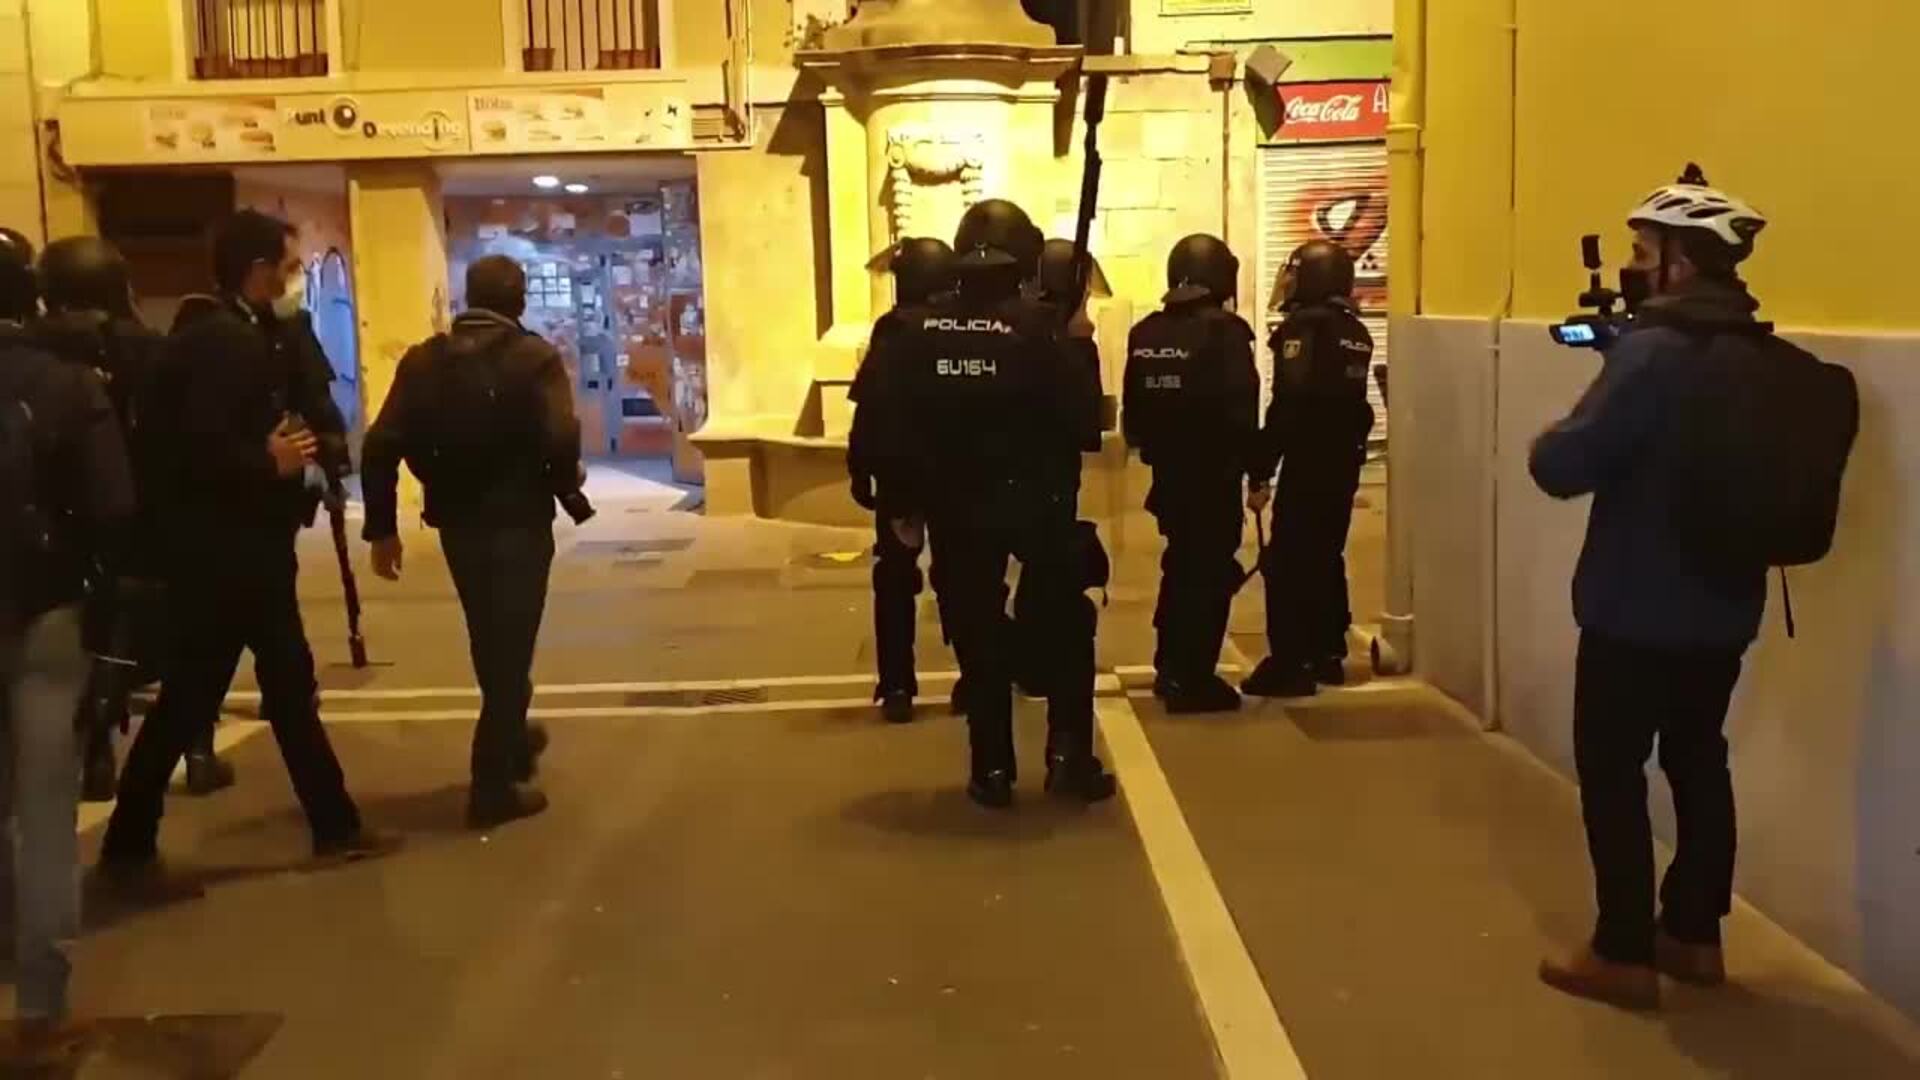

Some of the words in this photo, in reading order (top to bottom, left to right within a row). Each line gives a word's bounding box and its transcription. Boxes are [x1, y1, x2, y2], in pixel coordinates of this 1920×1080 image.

[923, 318, 1004, 332] POLICIA
[1133, 347, 1184, 359] POLICIA
[936, 358, 997, 376] 6U164
